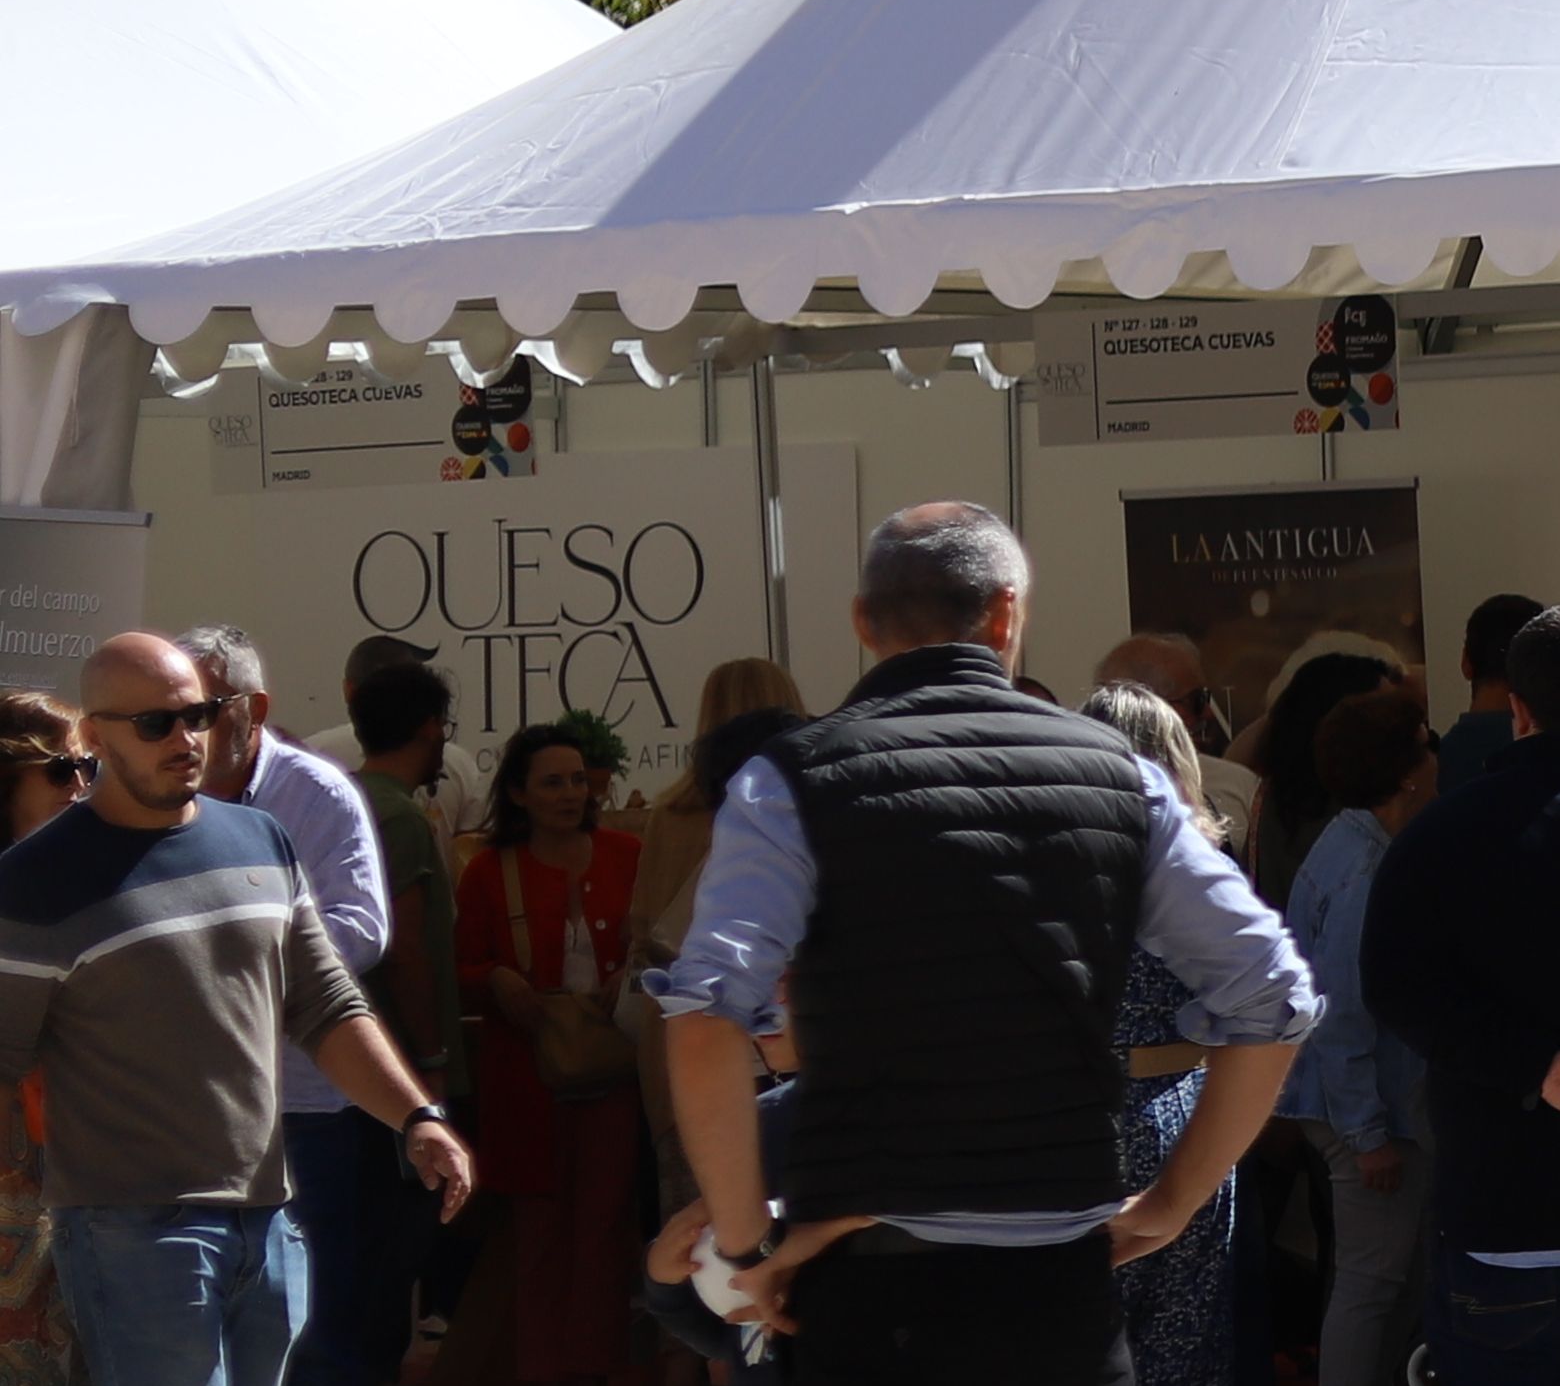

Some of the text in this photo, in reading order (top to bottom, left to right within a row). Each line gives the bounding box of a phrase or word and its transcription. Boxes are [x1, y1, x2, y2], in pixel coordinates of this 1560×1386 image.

[1122, 318, 1139, 332] 127
[1150, 317, 1168, 330] 128
[1179, 316, 1198, 329] 129
[1104, 331, 1275, 356] QUESOTECA CUEVAS
[335, 369, 353, 383] 129
[268, 383, 423, 409] QUESOTECA CUEVAS
[1107, 421, 1150, 434] MADRID
[272, 469, 311, 483] MADRID
[1171, 527, 1375, 564] LA ANTIGUA
[10, 584, 38, 609] del
[43, 589, 101, 617] campo
[352, 519, 705, 658] QUESO
[0, 621, 96, 659] lmuerzo
[461, 621, 679, 734] TECA
